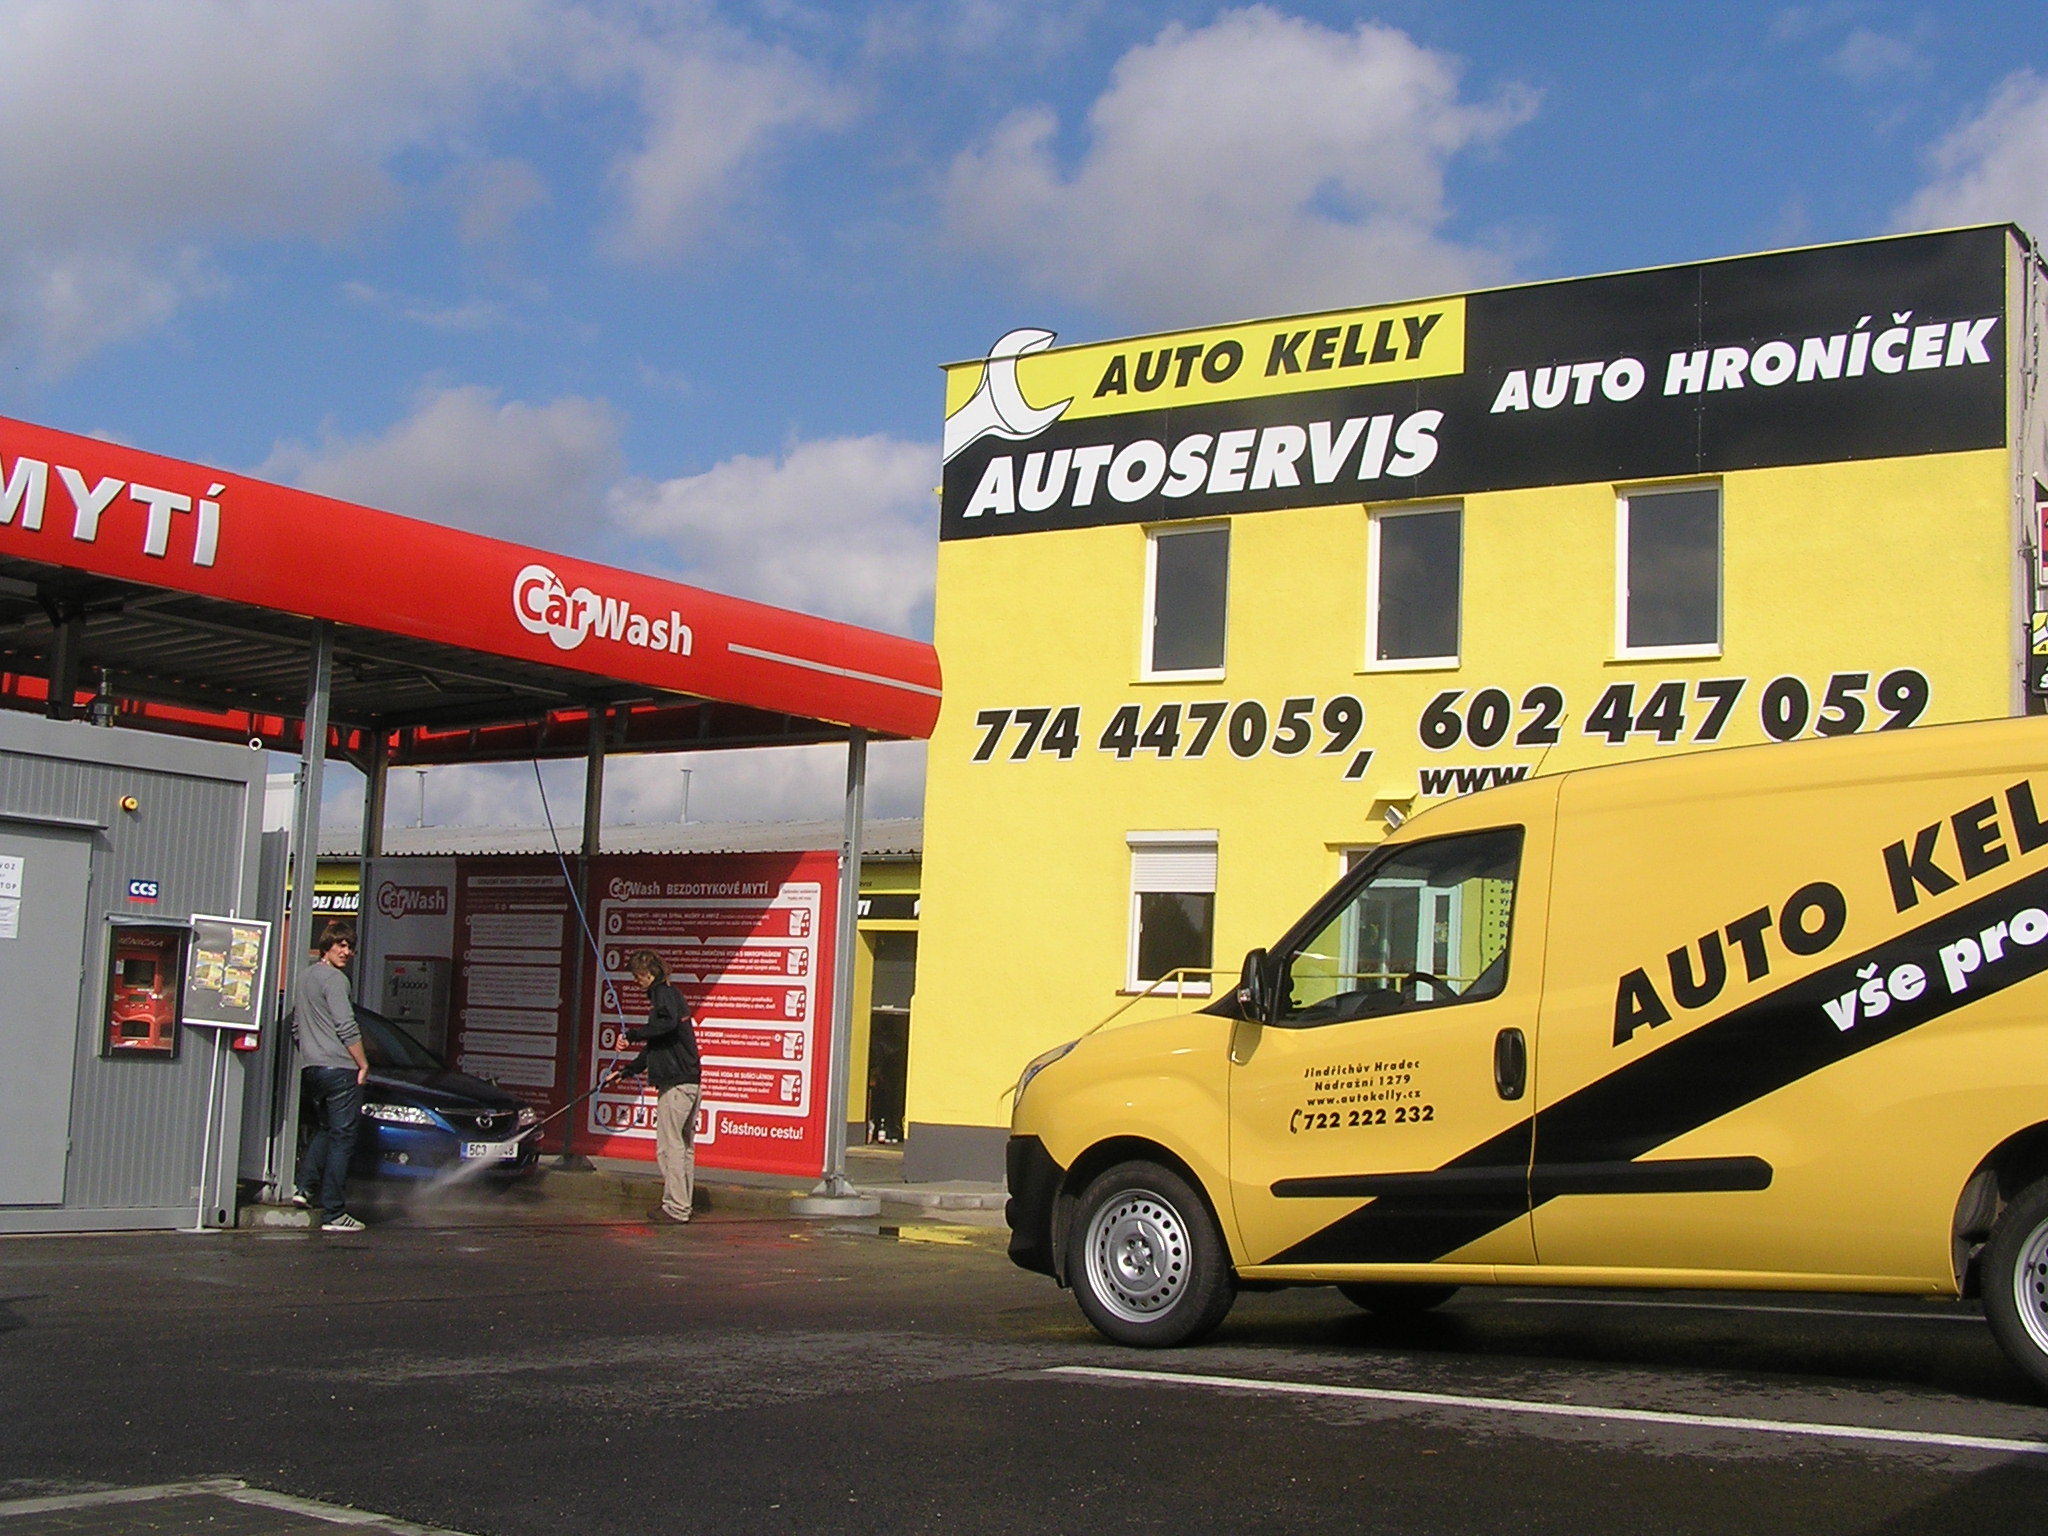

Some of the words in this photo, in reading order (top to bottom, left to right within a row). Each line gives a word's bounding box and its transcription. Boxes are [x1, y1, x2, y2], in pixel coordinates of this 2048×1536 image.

[1093, 340, 1244, 399] AUTO
[1264, 312, 1444, 378] KELLY
[1489, 357, 1645, 414] AUTO
[1663, 311, 1998, 396] HRONÍČEK
[962, 410, 1445, 518] AUTOSERVIS
[0, 456, 226, 567] MYTÍ
[514, 564, 693, 656] CarWash
[970, 706, 1082, 763] 774
[1417, 684, 1566, 751] 602
[1584, 677, 1748, 745] 447
[1759, 667, 1931, 743] 059
[130, 881, 157, 897] CCS
[666, 882, 740, 895] BEZDOTYKOVÉ
[741, 881, 769, 895] MYTÍ
[1612, 881, 1848, 1048] AUTO
[1822, 961, 1927, 1033] vše
[1939, 907, 2048, 995] pro
[1304, 1063, 1370, 1078] Jindřichův
[1374, 1059, 1420, 1072] Hradec
[1307, 1089, 1421, 1106] www.autokelly.cz
[1314, 1077, 1374, 1091] Nádražní
[1379, 1074, 1411, 1086] 1279
[720, 1117, 767, 1138] Šťastnou
[770, 1123, 804, 1140] cestu!
[1304, 1112, 1341, 1130] 722
[1348, 1108, 1387, 1126] 222
[1394, 1105, 1434, 1123] 232
